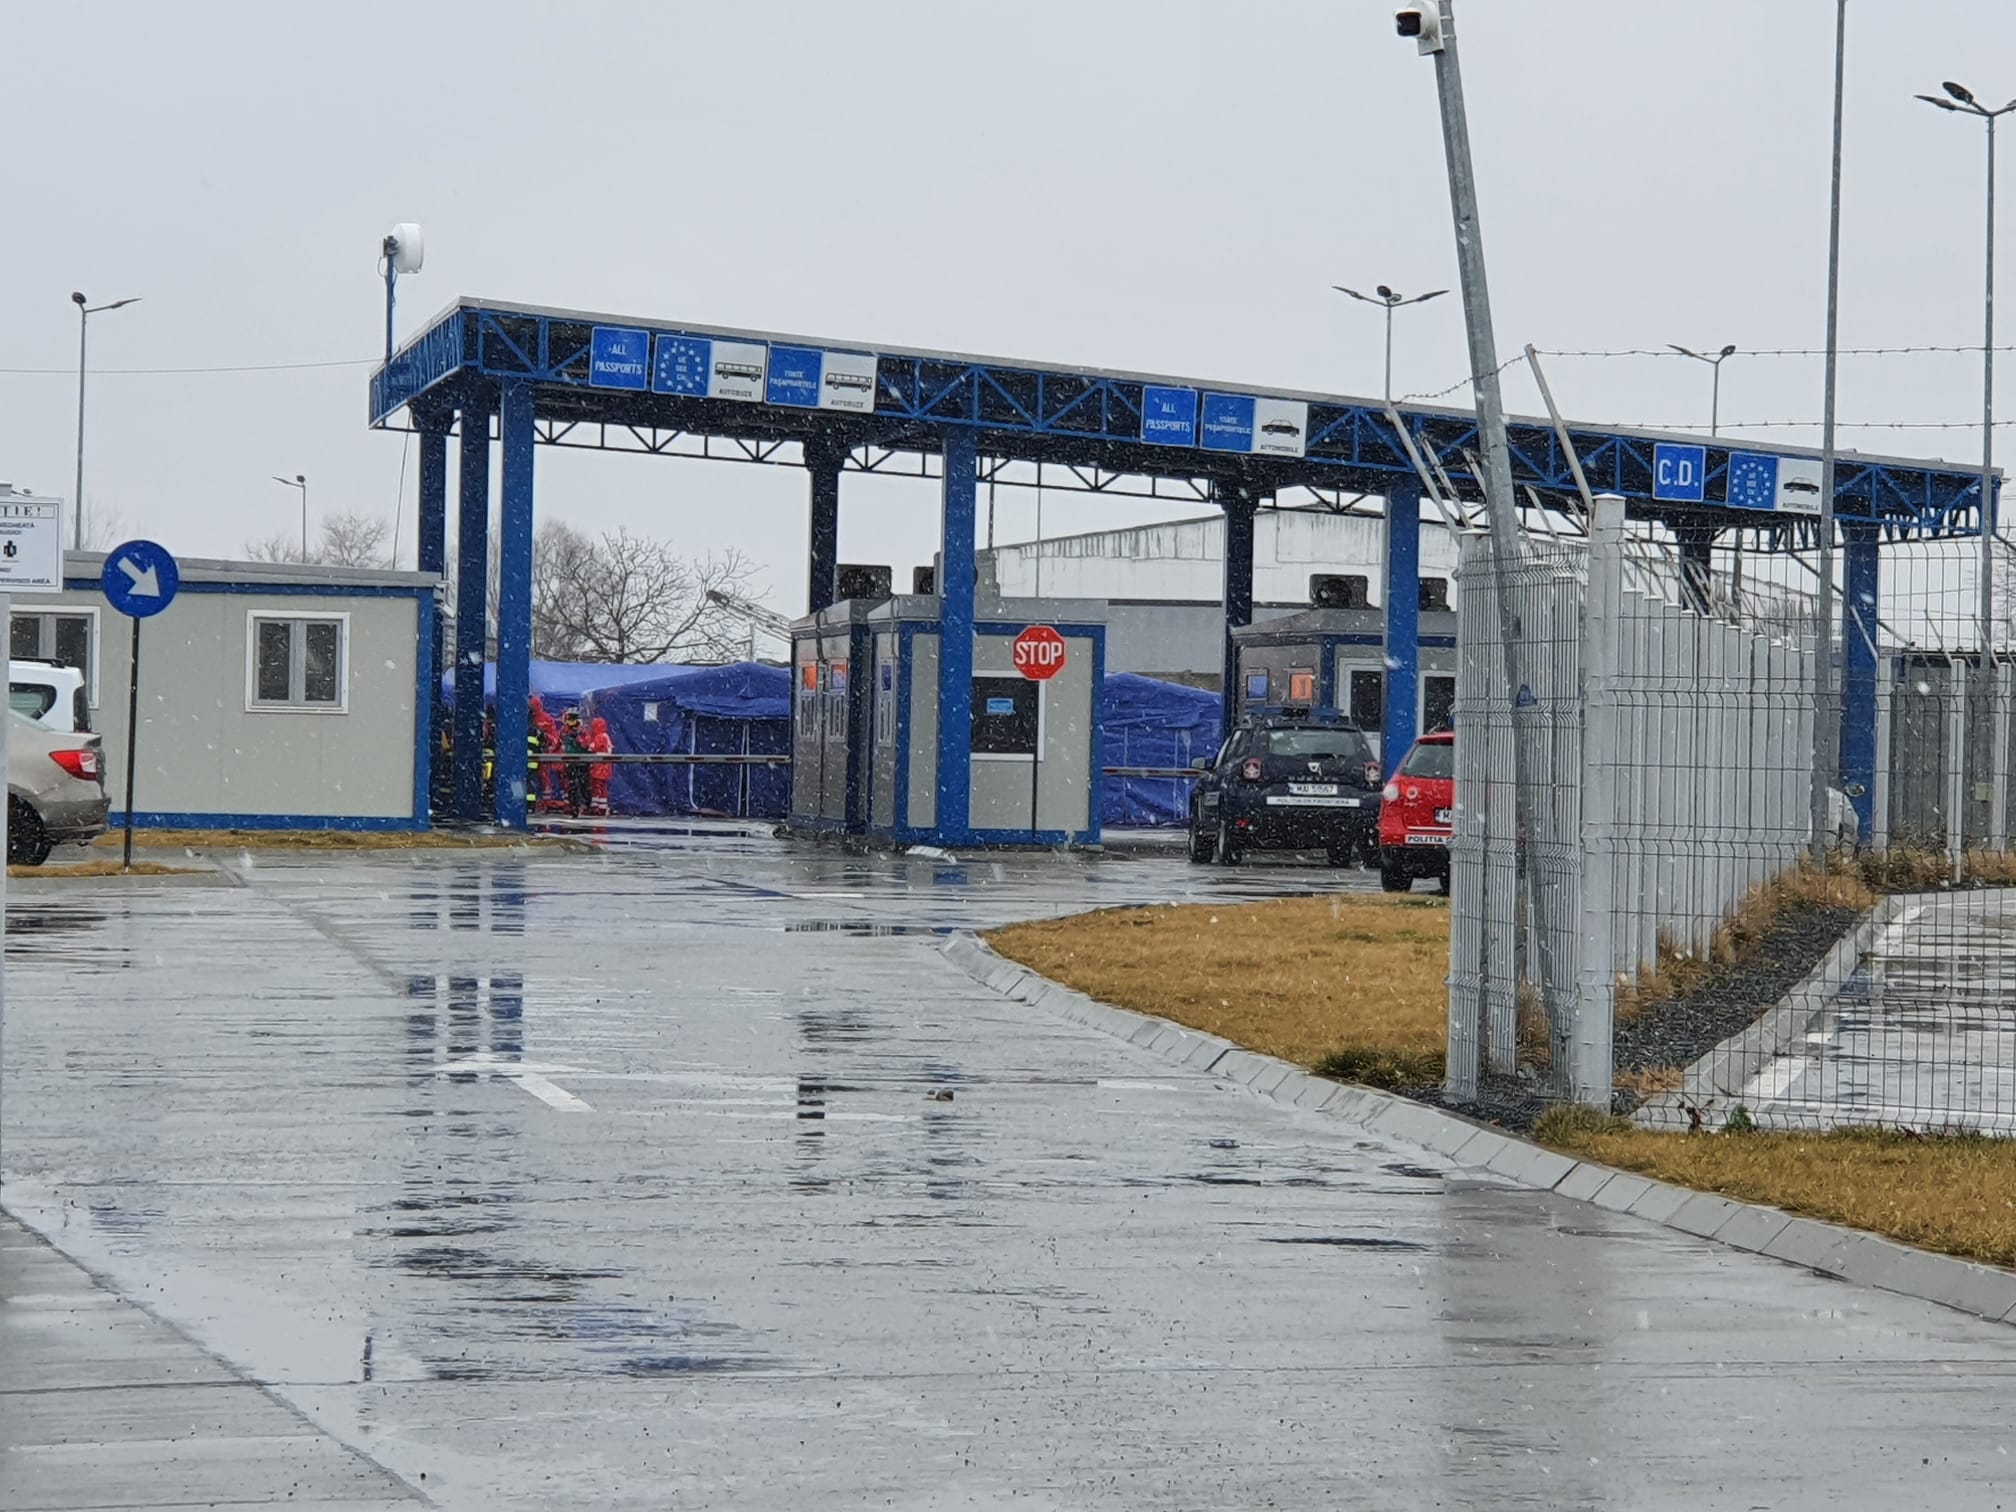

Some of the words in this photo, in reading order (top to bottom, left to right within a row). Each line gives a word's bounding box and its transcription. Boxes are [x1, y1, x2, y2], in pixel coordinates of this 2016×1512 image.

[611, 343, 627, 356] ALL
[594, 360, 643, 376] PASSPORTS
[1161, 401, 1176, 413] ALL
[1145, 418, 1190, 433] PASSPORTS
[1658, 459, 1699, 487] C.D.
[1015, 641, 1063, 666] STOP
